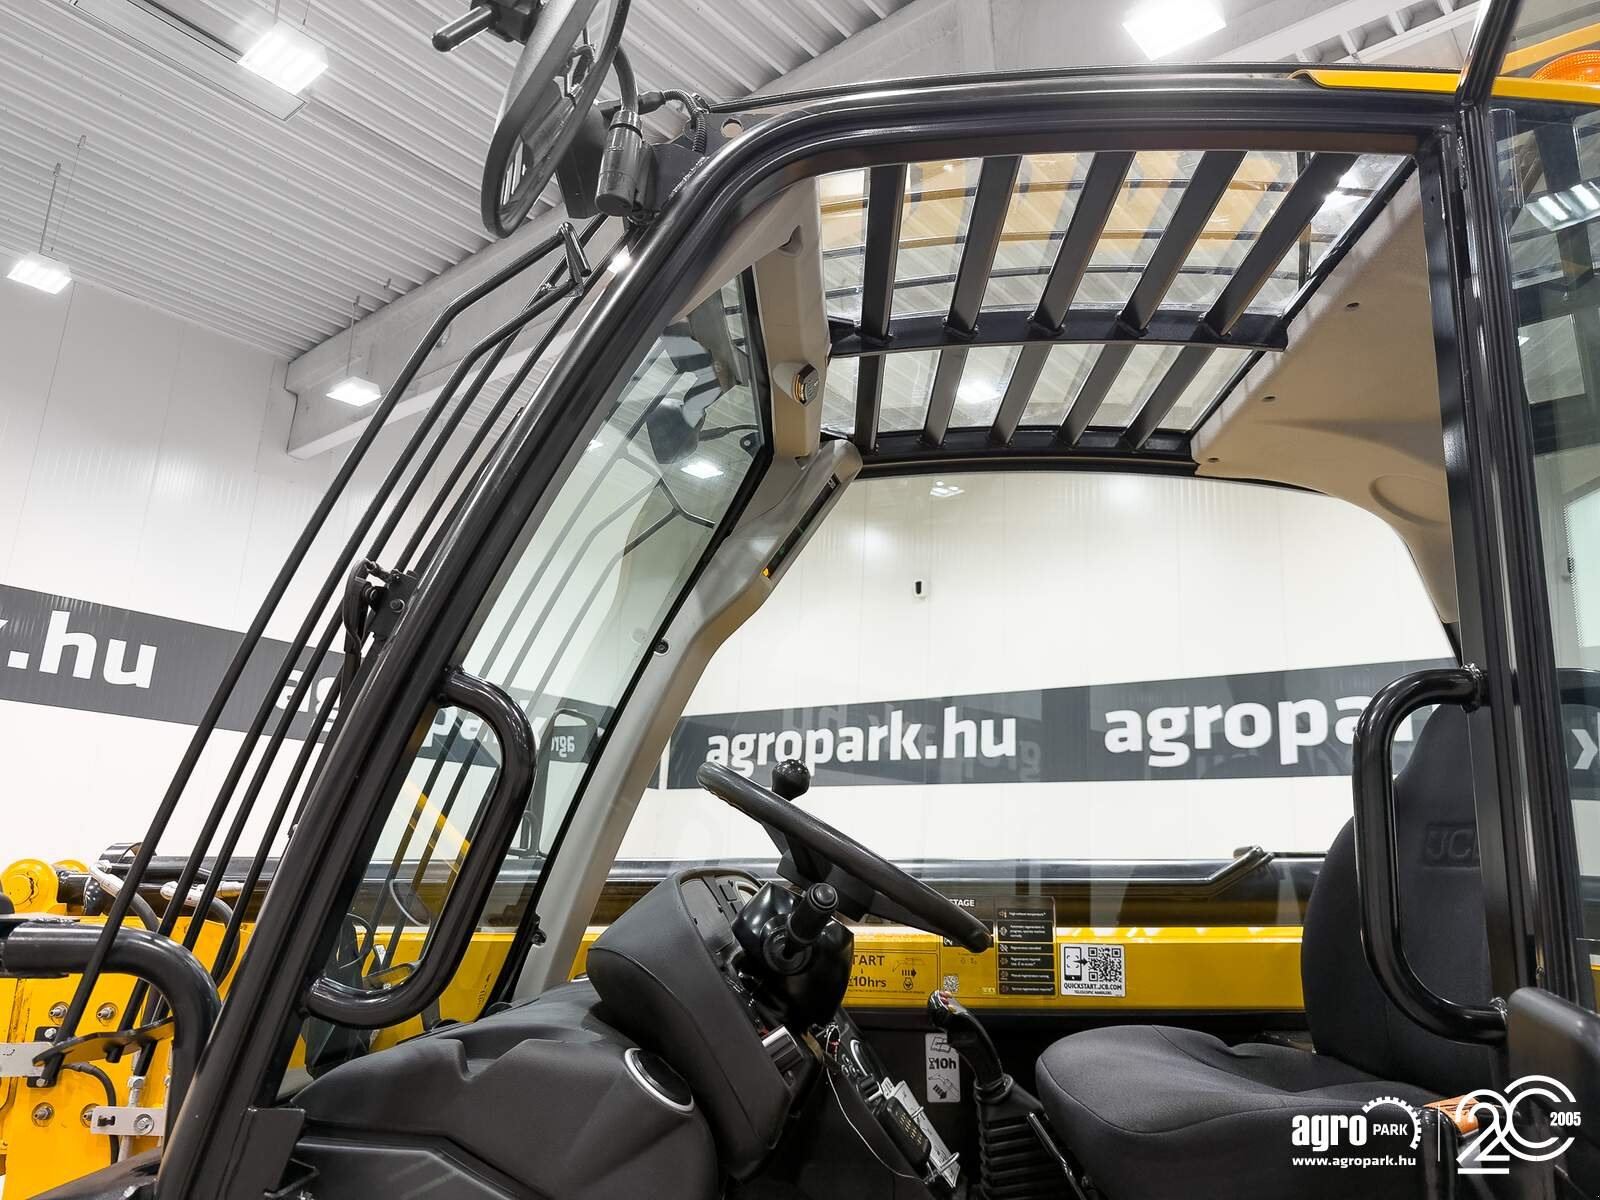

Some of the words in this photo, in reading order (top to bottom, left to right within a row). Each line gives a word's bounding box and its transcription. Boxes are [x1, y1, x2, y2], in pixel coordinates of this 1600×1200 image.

[0, 611, 158, 689] .hu
[705, 706, 1017, 779] agropark.hu
[1104, 688, 1416, 768] agropa
[1425, 828, 1480, 858] JC
[934, 1057, 957, 1070] 10h
